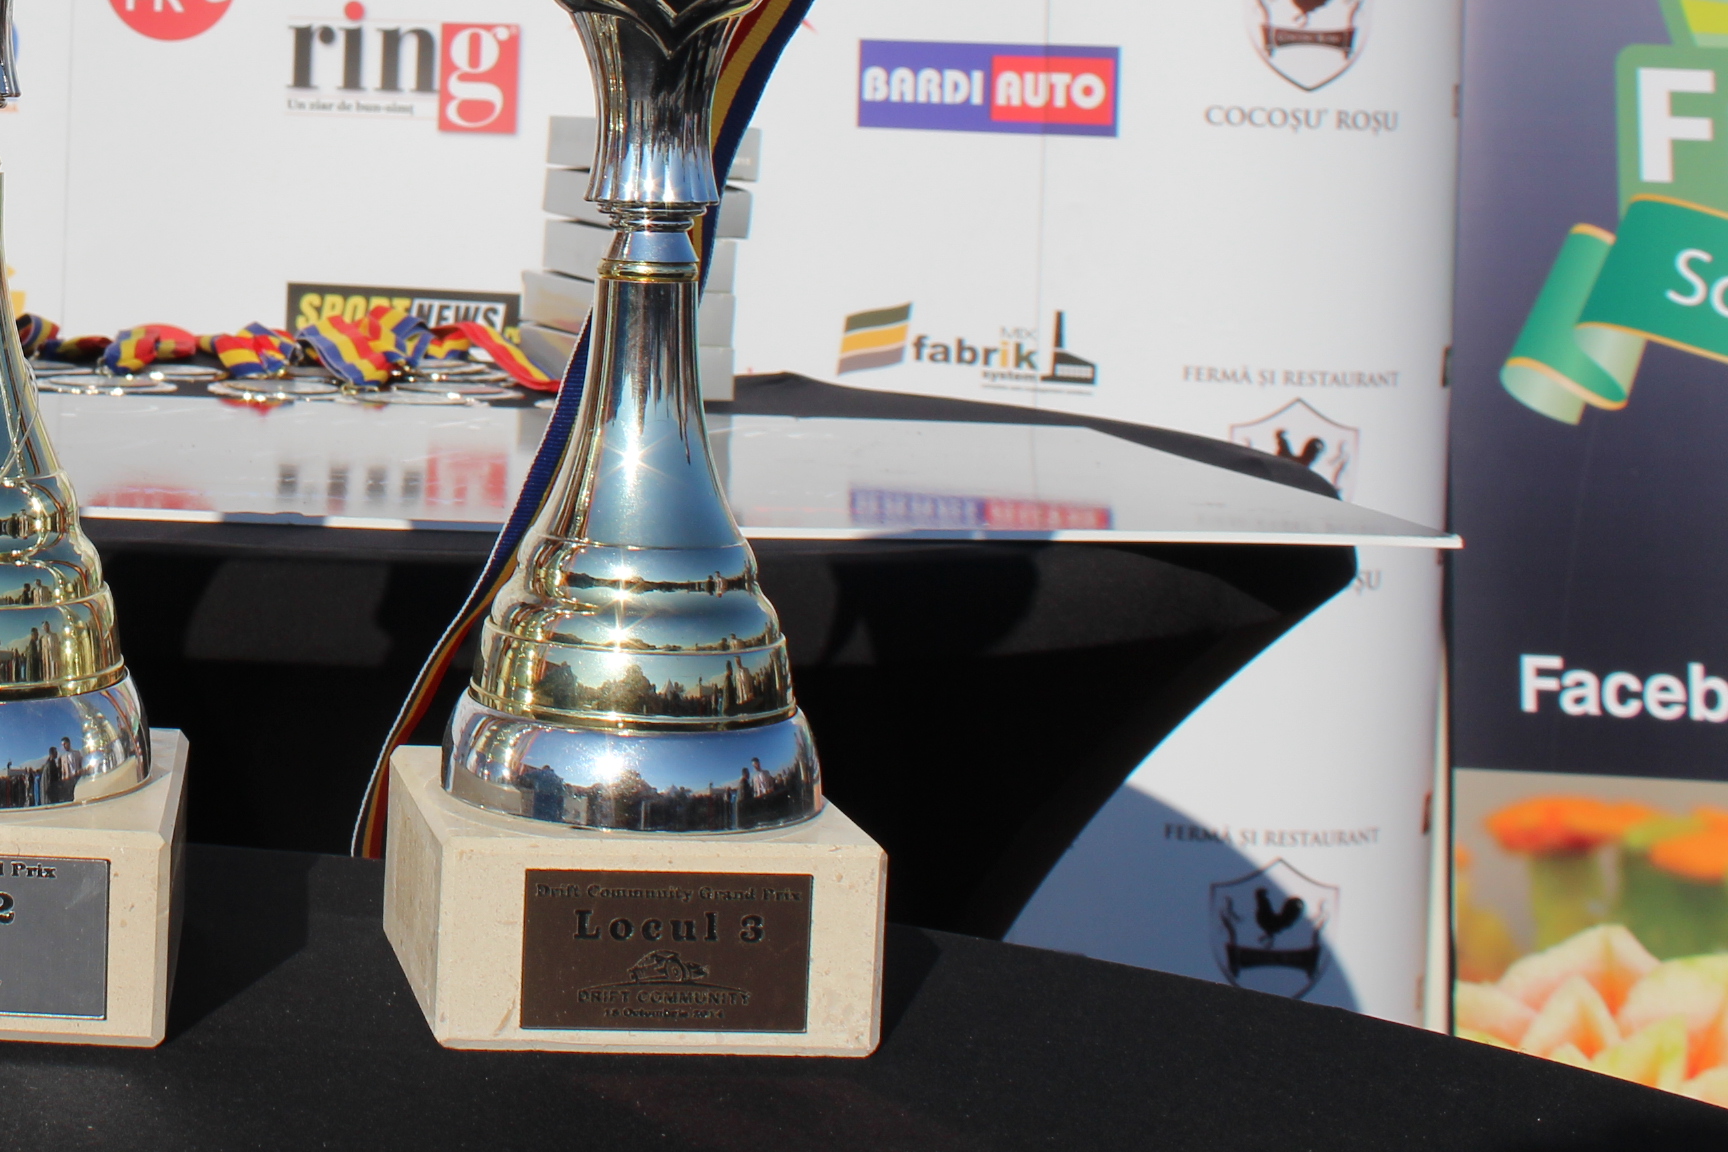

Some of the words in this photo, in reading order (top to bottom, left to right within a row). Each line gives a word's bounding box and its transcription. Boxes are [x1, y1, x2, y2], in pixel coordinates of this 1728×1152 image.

[286, 0, 512, 129] ring
[862, 66, 986, 106] BARDI
[996, 71, 1107, 110] AUTO
[911, 334, 1039, 371] fabrik
[1282, 368, 1401, 389] RESTAURANT
[1519, 653, 1728, 724] Faceb
[1263, 825, 1382, 848] RESTAURANT
[10, 861, 57, 879] Prix
[536, 882, 581, 899] Drift
[587, 884, 693, 904] Community
[698, 885, 757, 902] Grand
[762, 887, 802, 903] Prix
[572, 908, 720, 944] Locul
[738, 913, 766, 945] 3
[576, 988, 631, 1004] DRIFT
[636, 989, 753, 1007] COMMUNITY
